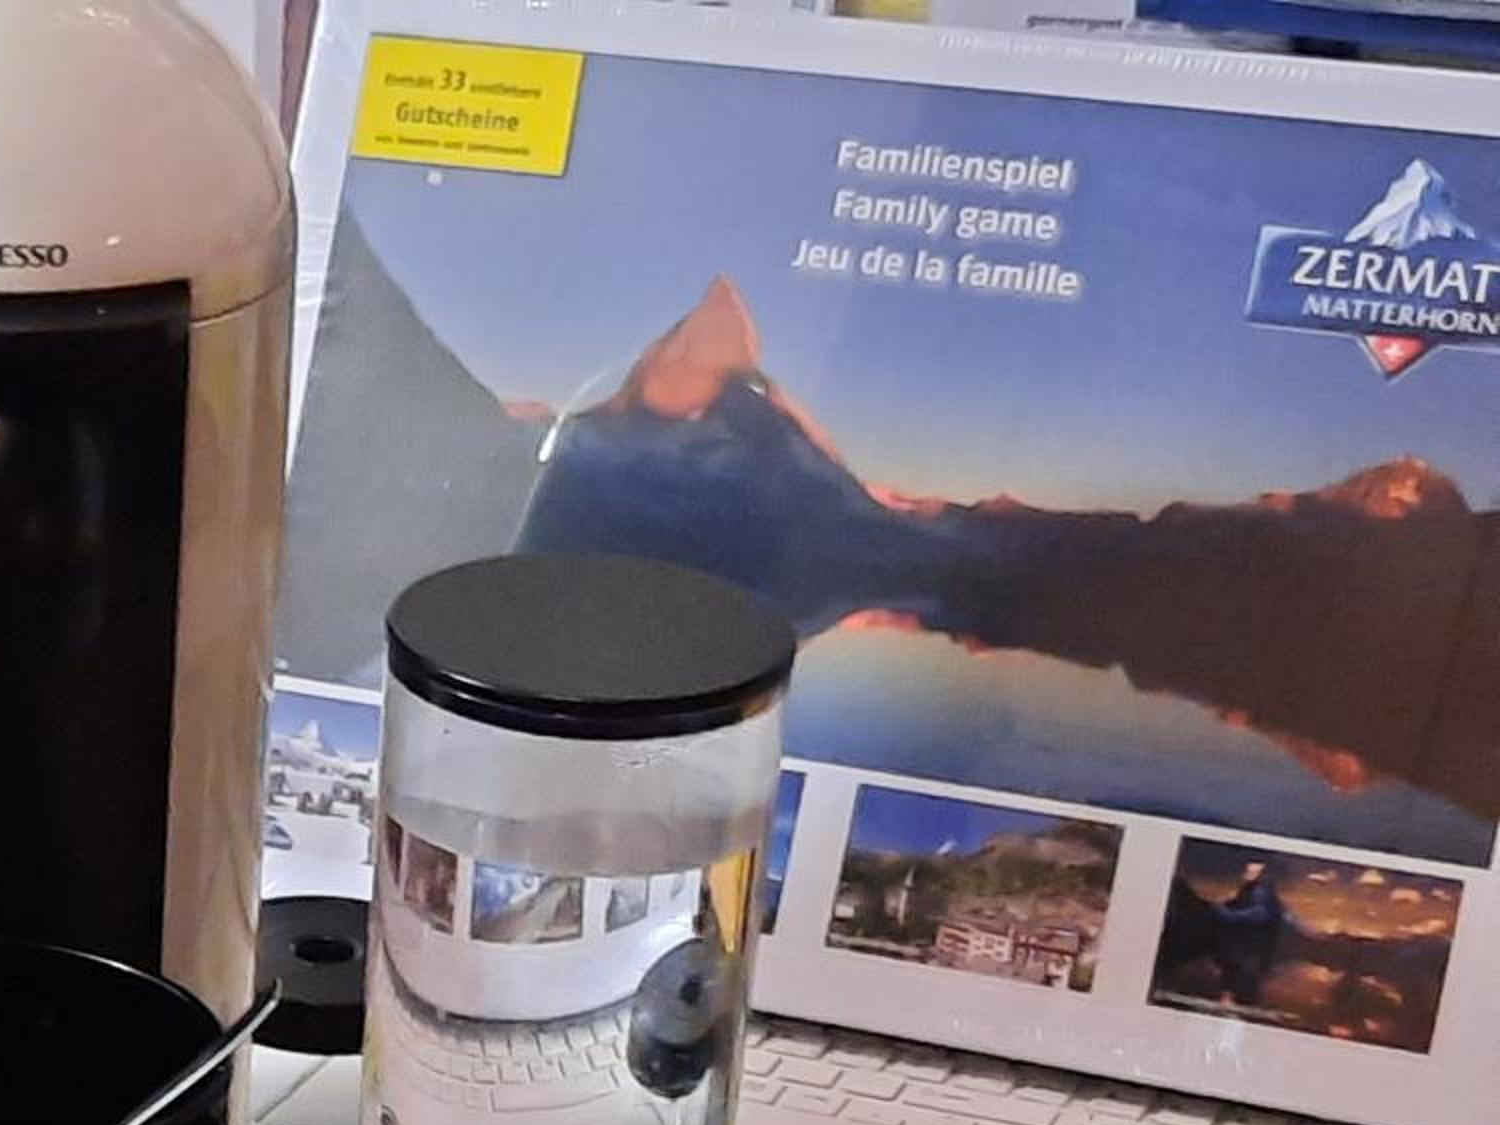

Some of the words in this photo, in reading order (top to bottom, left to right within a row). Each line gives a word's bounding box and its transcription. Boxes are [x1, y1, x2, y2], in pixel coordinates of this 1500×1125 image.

[438, 68, 468, 92] 33
[395, 101, 520, 132] Gutscheine
[836, 140, 1075, 192] Familienspiel
[832, 190, 949, 235] Family
[955, 206, 1058, 241] game
[790, 239, 850, 271] Jeu
[860, 246, 905, 277] de
[913, 250, 944, 282] la
[956, 254, 1079, 297] famille
